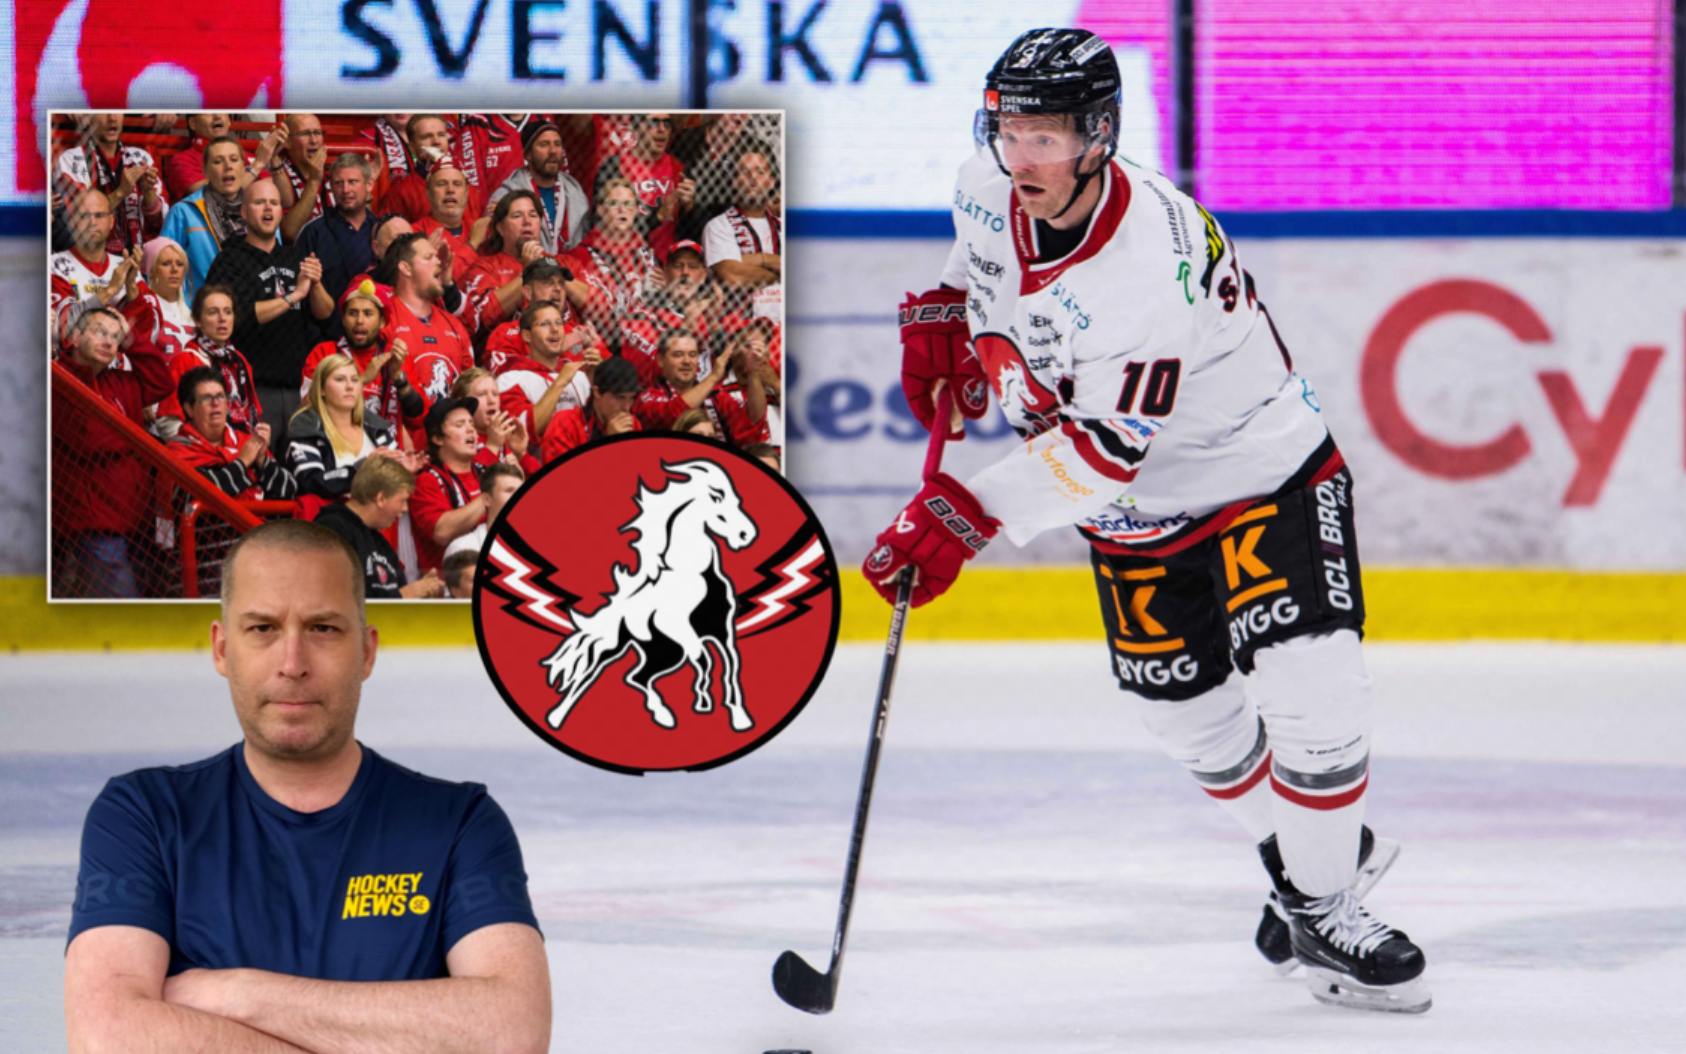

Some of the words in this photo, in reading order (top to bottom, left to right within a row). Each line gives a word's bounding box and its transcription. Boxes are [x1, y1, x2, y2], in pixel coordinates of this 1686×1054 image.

[340, 0, 932, 82] SVENSKA
[1000, 95, 1042, 106] SVENSKA
[1000, 104, 1022, 113] SPEL
[1116, 358, 1181, 417] 10
[1358, 277, 1686, 509] Cy
[1221, 525, 1272, 591] K
[1323, 557, 1353, 611] OCL
[1229, 596, 1300, 651] BYGG
[1115, 654, 1198, 686] BYGG
[342, 893, 407, 920] NEWS
[347, 872, 423, 895] HOCKEY
